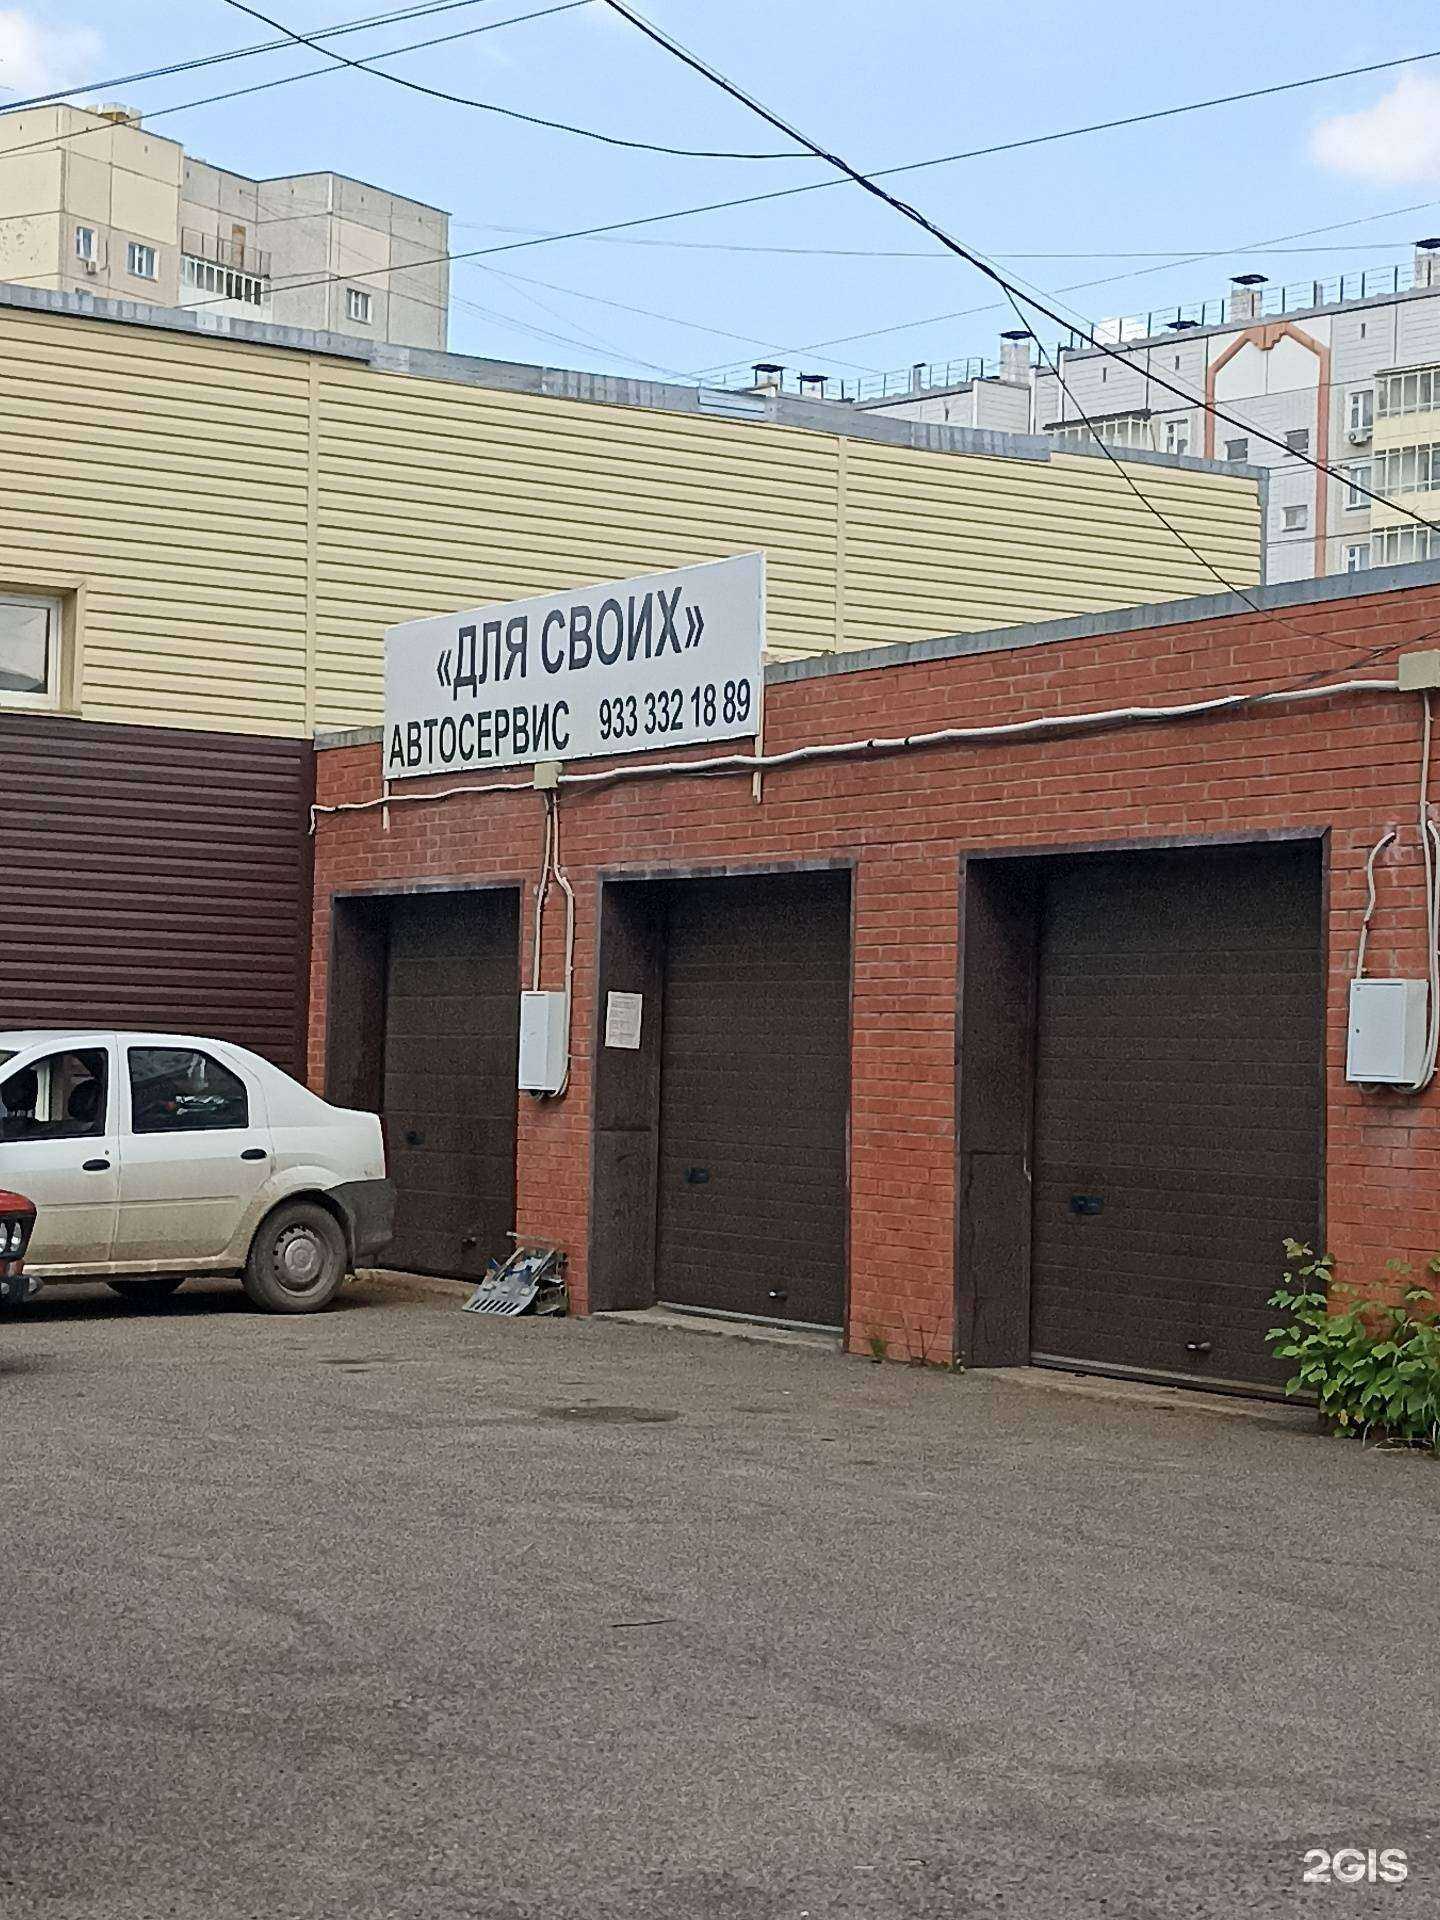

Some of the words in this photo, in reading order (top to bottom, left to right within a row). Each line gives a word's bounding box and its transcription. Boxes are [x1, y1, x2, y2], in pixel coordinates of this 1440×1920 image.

[436, 616, 529, 700] «ДЛЯ
[541, 586, 705, 674] СВОИХ»
[389, 700, 570, 767] АВТОСЕРВИС
[599, 695, 637, 740] 933
[644, 688, 683, 734] 332
[691, 683, 717, 727] 18
[723, 678, 751, 722] 89
